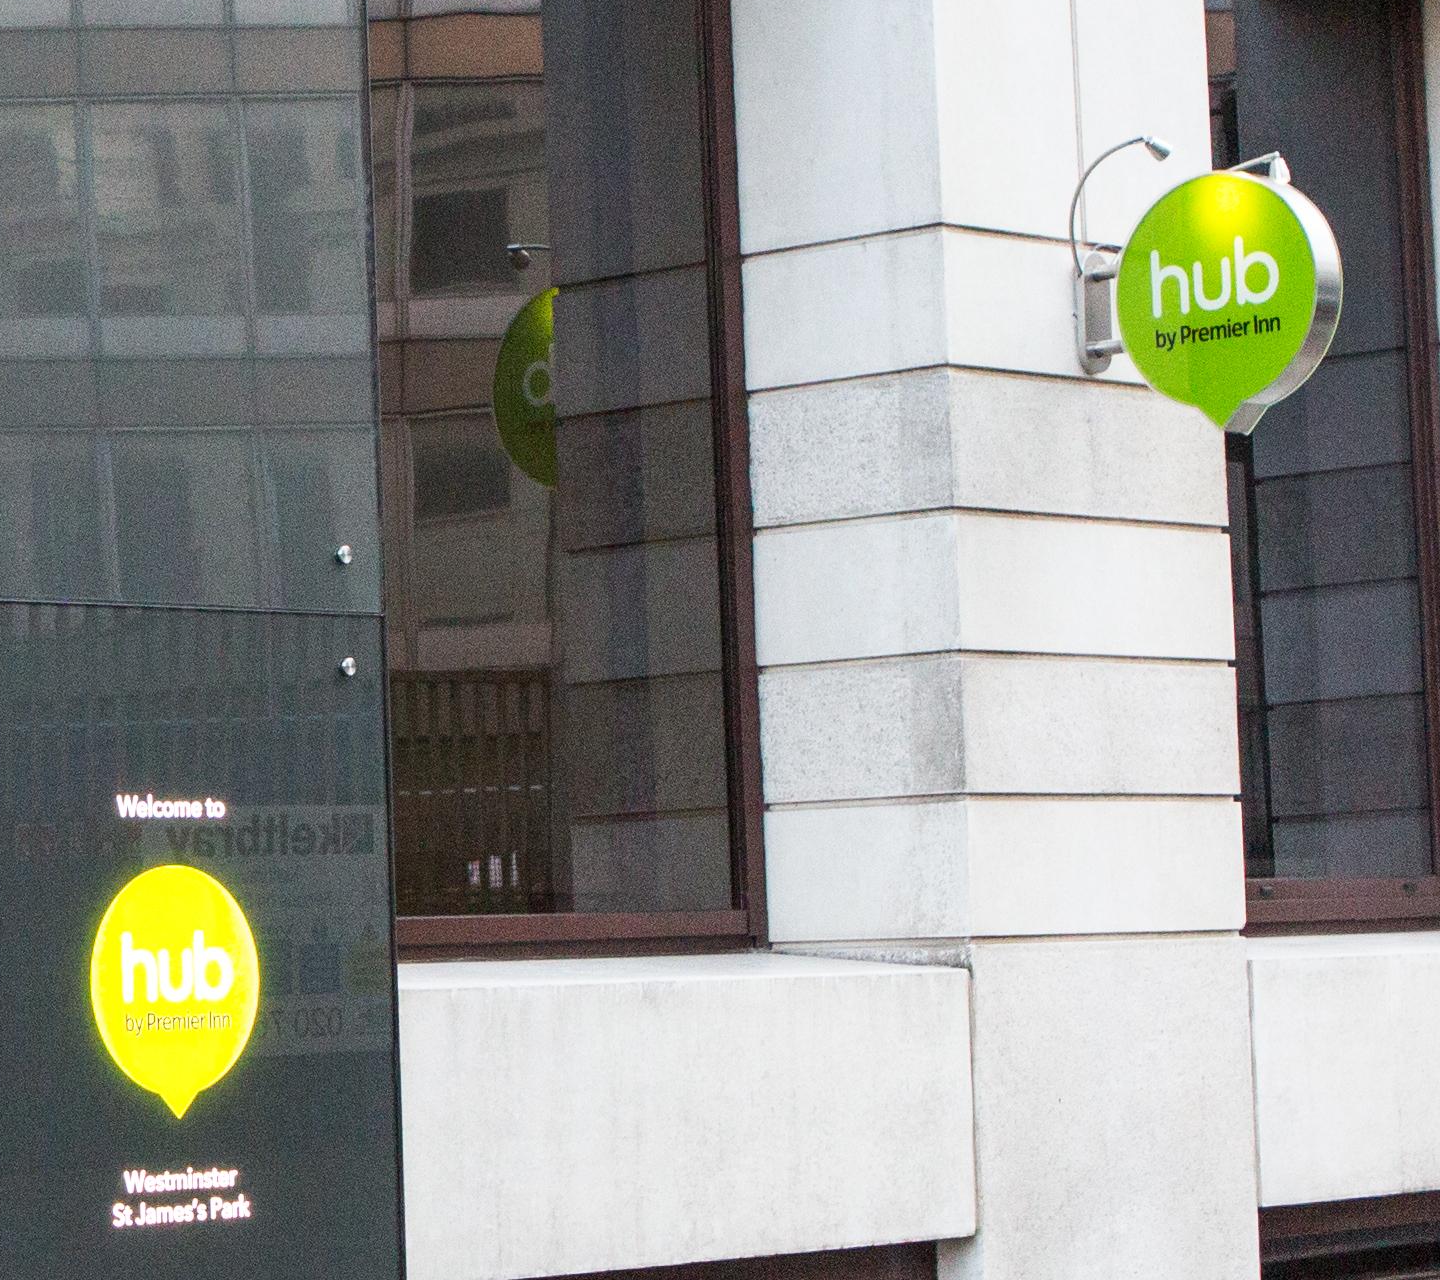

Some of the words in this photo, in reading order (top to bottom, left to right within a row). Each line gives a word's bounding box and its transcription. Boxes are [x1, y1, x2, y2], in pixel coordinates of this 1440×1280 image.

[1149, 235, 1281, 319] hub
[1154, 329, 1177, 352] by
[1180, 317, 1252, 346] Premier
[1253, 314, 1281, 336] Inn
[116, 793, 202, 820] Welcome
[204, 796, 227, 819] to
[120, 929, 236, 1004] hub
[125, 1012, 144, 1036] by
[147, 1011, 205, 1033] Premier
[207, 1010, 233, 1030] Inn
[123, 1166, 239, 1194] Westminster
[111, 1201, 135, 1229] St
[210, 1194, 252, 1219] Park
